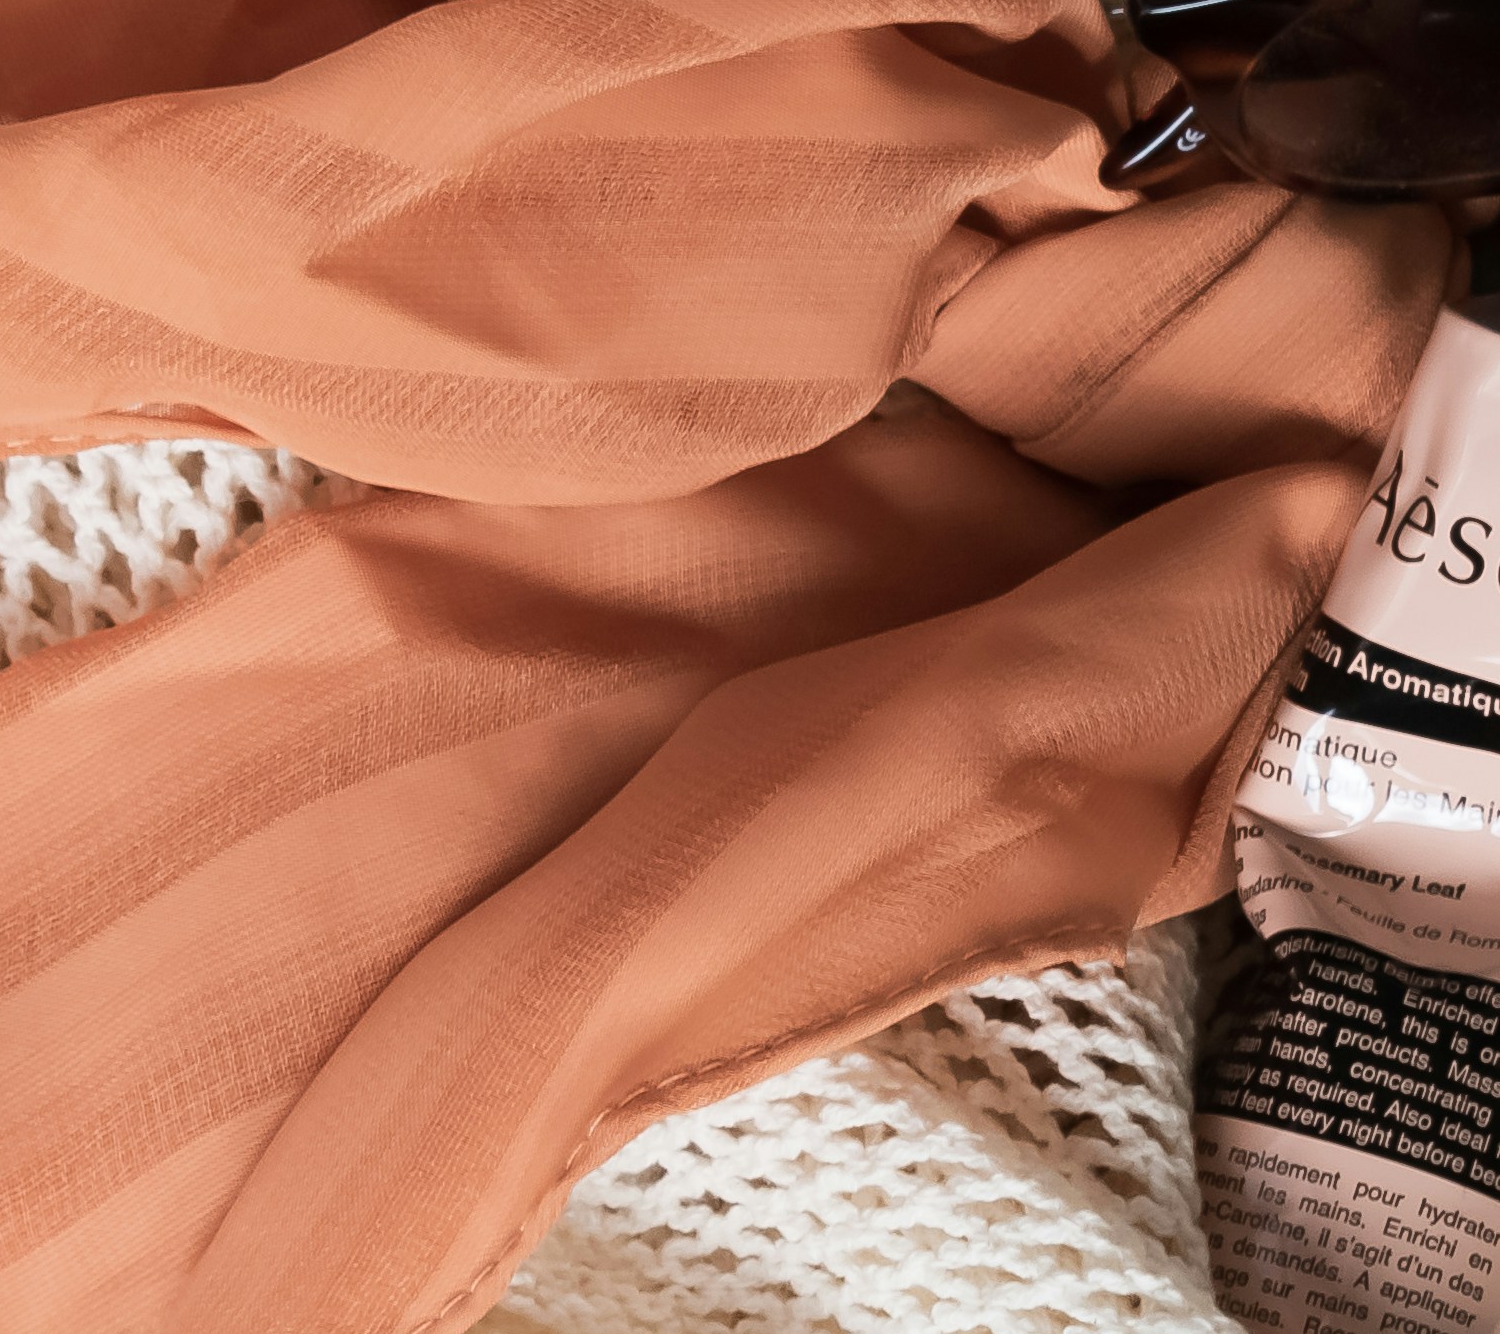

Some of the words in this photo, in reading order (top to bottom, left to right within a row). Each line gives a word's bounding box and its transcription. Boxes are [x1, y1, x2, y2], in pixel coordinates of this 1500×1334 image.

[1265, 719, 1399, 770] omatique
[1384, 778, 1428, 810] les
[1411, 874, 1467, 902] Leaf
[1411, 923, 1442, 942] de
[1307, 959, 1379, 996] hands.
[1402, 990, 1500, 1037] Enriched
[1334, 1026, 1435, 1074] products.
[1400, 1015, 1441, 1045] this
[1449, 1031, 1469, 1056] is
[1257, 1065, 1282, 1088] as
[1285, 1070, 1378, 1115] required.
[1382, 1098, 1435, 1132] Also
[1439, 1116, 1493, 1155] ideal
[1268, 1034, 1334, 1074] hands,
[1348, 1060, 1493, 1129] concentrating
[1240, 1087, 1275, 1116] feet
[1276, 1100, 1335, 1136] every
[1337, 1115, 1395, 1148] night
[1397, 1131, 1467, 1175] before
[1227, 1145, 1342, 1191] rapidement
[1352, 1178, 1407, 1209] pour
[1256, 1179, 1287, 1207] les
[1297, 1194, 1367, 1230] mains.
[1381, 1215, 1459, 1259] Enrichi
[1467, 1251, 1495, 1277] en
[1231, 1236, 1344, 1285] demandés.
[1352, 1269, 1372, 1293] A
[1378, 1279, 1478, 1331] appliquer
[1316, 1228, 1332, 1250] il
[1333, 1234, 1394, 1269] s'agit
[1396, 1253, 1444, 1285] d'un
[1447, 1272, 1485, 1304] des
[1260, 1274, 1296, 1300] sur
[1304, 1288, 1370, 1323] mains
